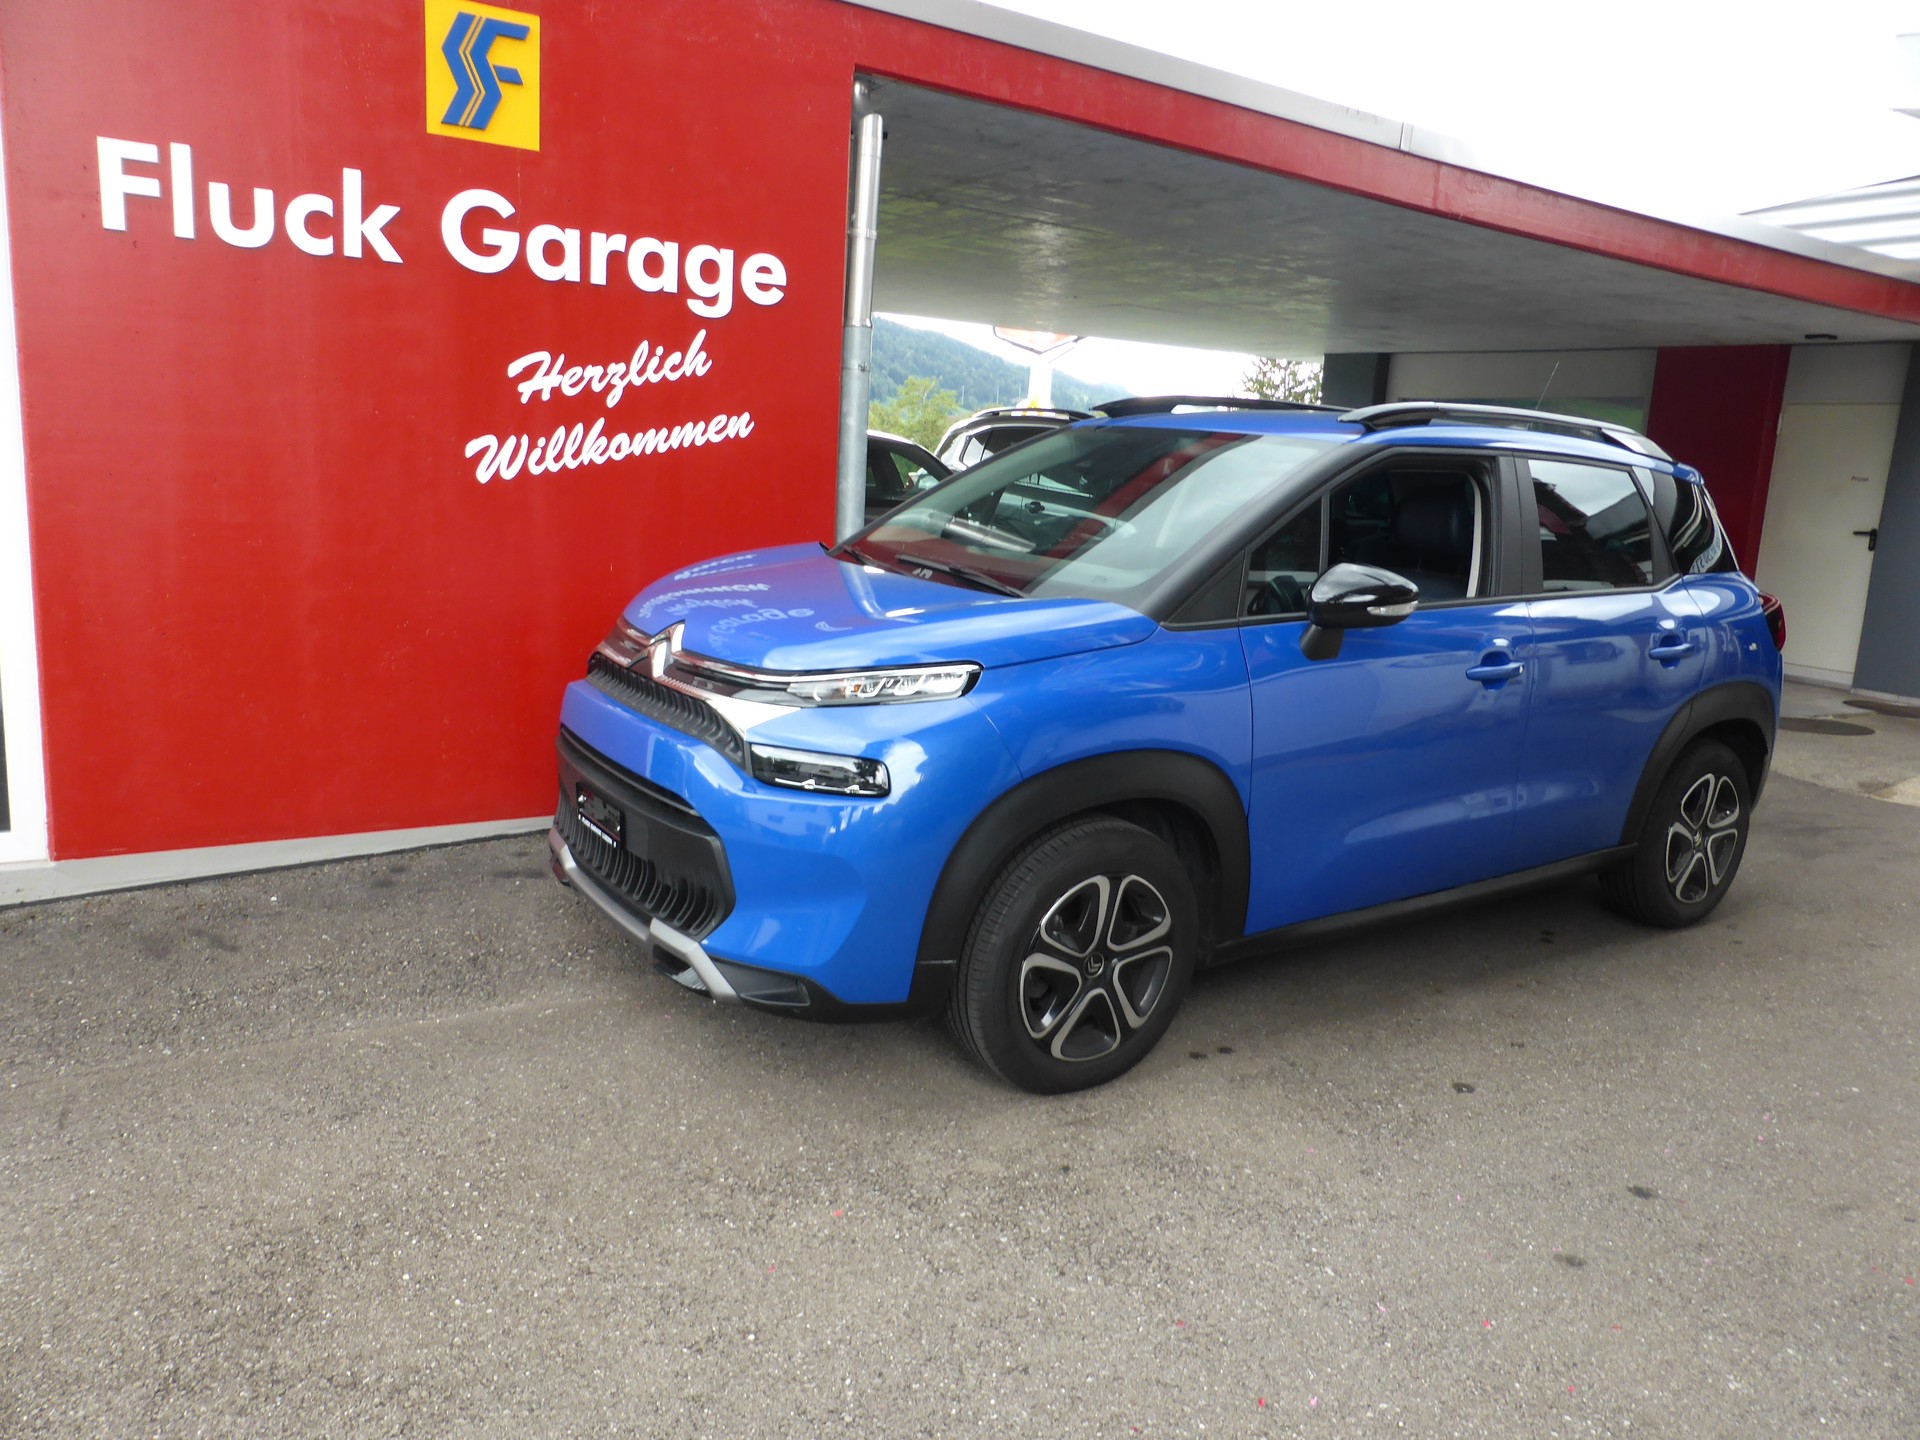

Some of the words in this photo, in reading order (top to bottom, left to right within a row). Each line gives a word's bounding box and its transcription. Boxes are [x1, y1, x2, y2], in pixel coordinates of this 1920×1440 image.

[95, 135, 404, 264] Fluck
[440, 188, 787, 319] Garage
[507, 329, 712, 409] Herzlich
[465, 411, 755, 485] Willkommen
